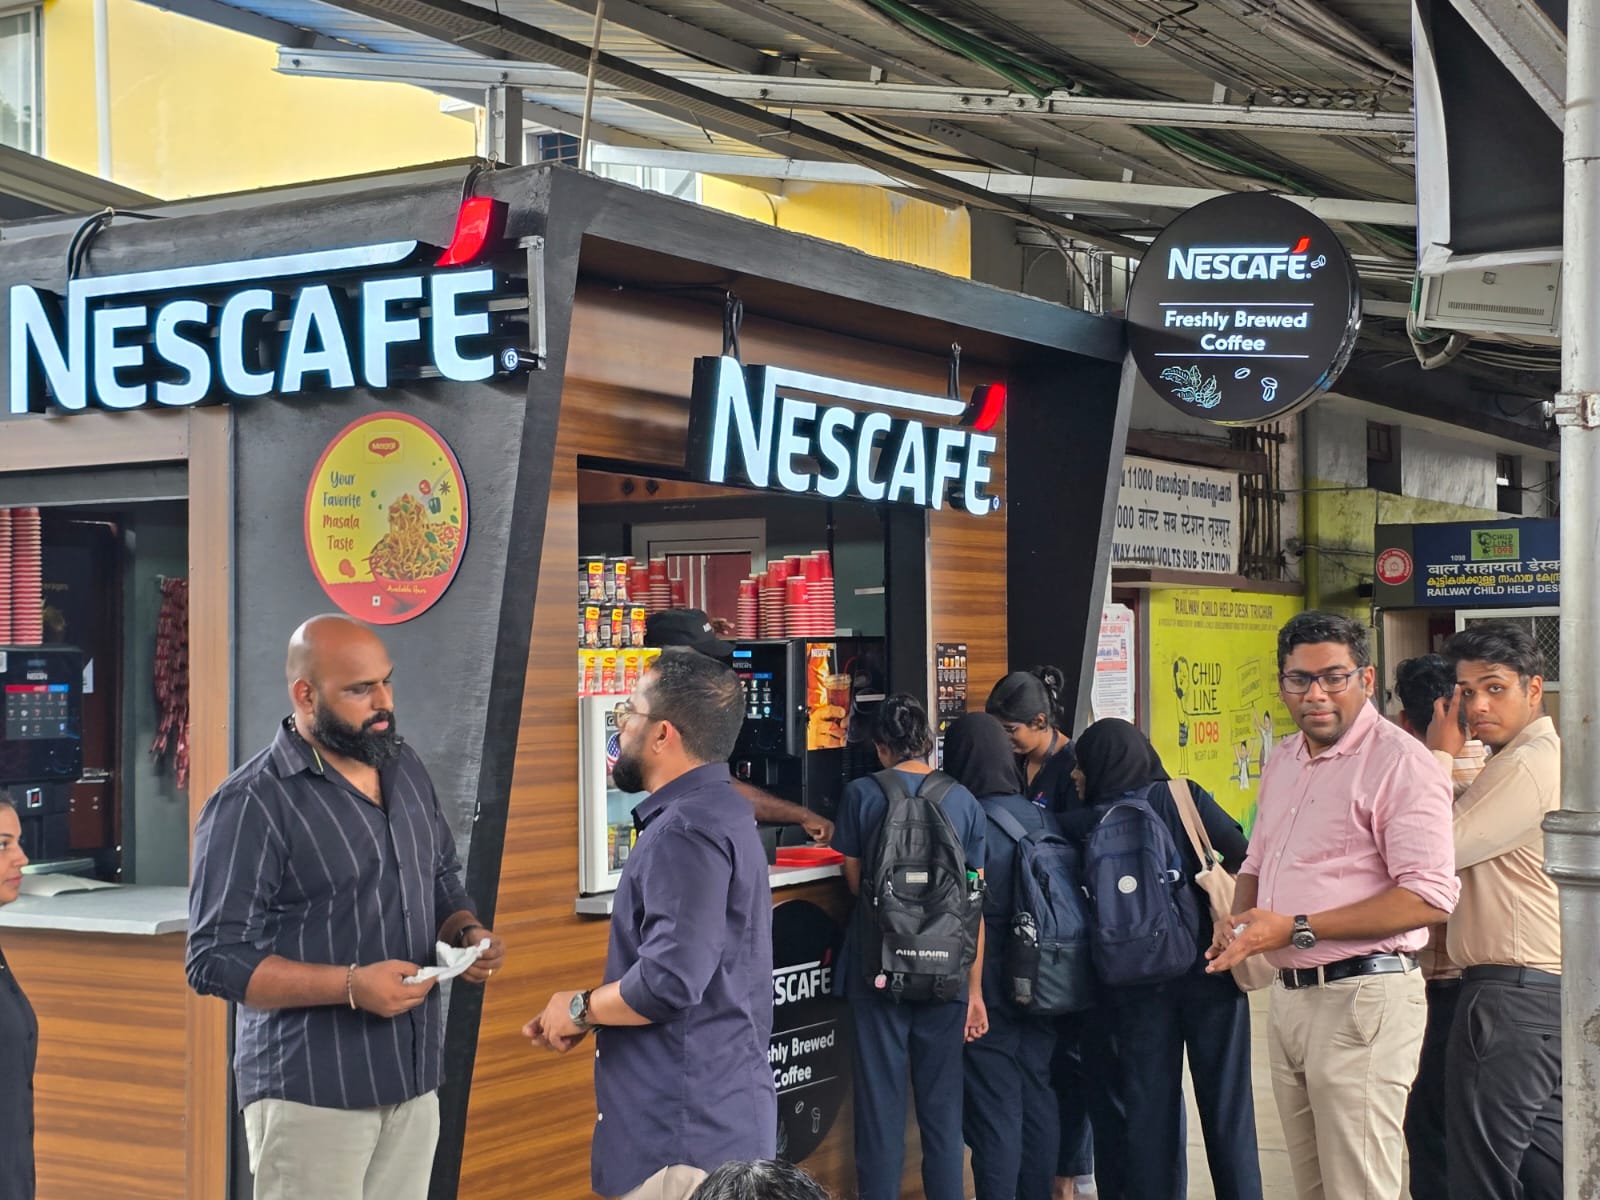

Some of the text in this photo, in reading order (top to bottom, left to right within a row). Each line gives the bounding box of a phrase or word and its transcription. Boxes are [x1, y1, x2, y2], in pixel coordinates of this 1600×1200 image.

[1165, 310, 1308, 331] Freshly Brewed
[1201, 334, 1266, 351] Coffee
[330, 471, 355, 488] Your
[1127, 466, 1153, 491] 11000
[323, 493, 361, 508] Favorite
[328, 534, 354, 552] Taste
[1157, 546, 1181, 568] VOLTS
[1201, 551, 1231, 572] STATION
[1426, 563, 1460, 575] बाल
[1463, 561, 1522, 575] सहायता
[1427, 583, 1560, 597] RAILWAY CHILD HELP DES
[1201, 600, 1218, 617] CHILD
[1219, 601, 1234, 618] HELP
[1235, 602, 1249, 619] DESK
[1191, 662, 1222, 686] CHILD
[1193, 688, 1217, 711] LINE
[1193, 721, 1219, 744] 1098
[791, 1029, 835, 1056] Brewed
[772, 1065, 812, 1089] Coffee
